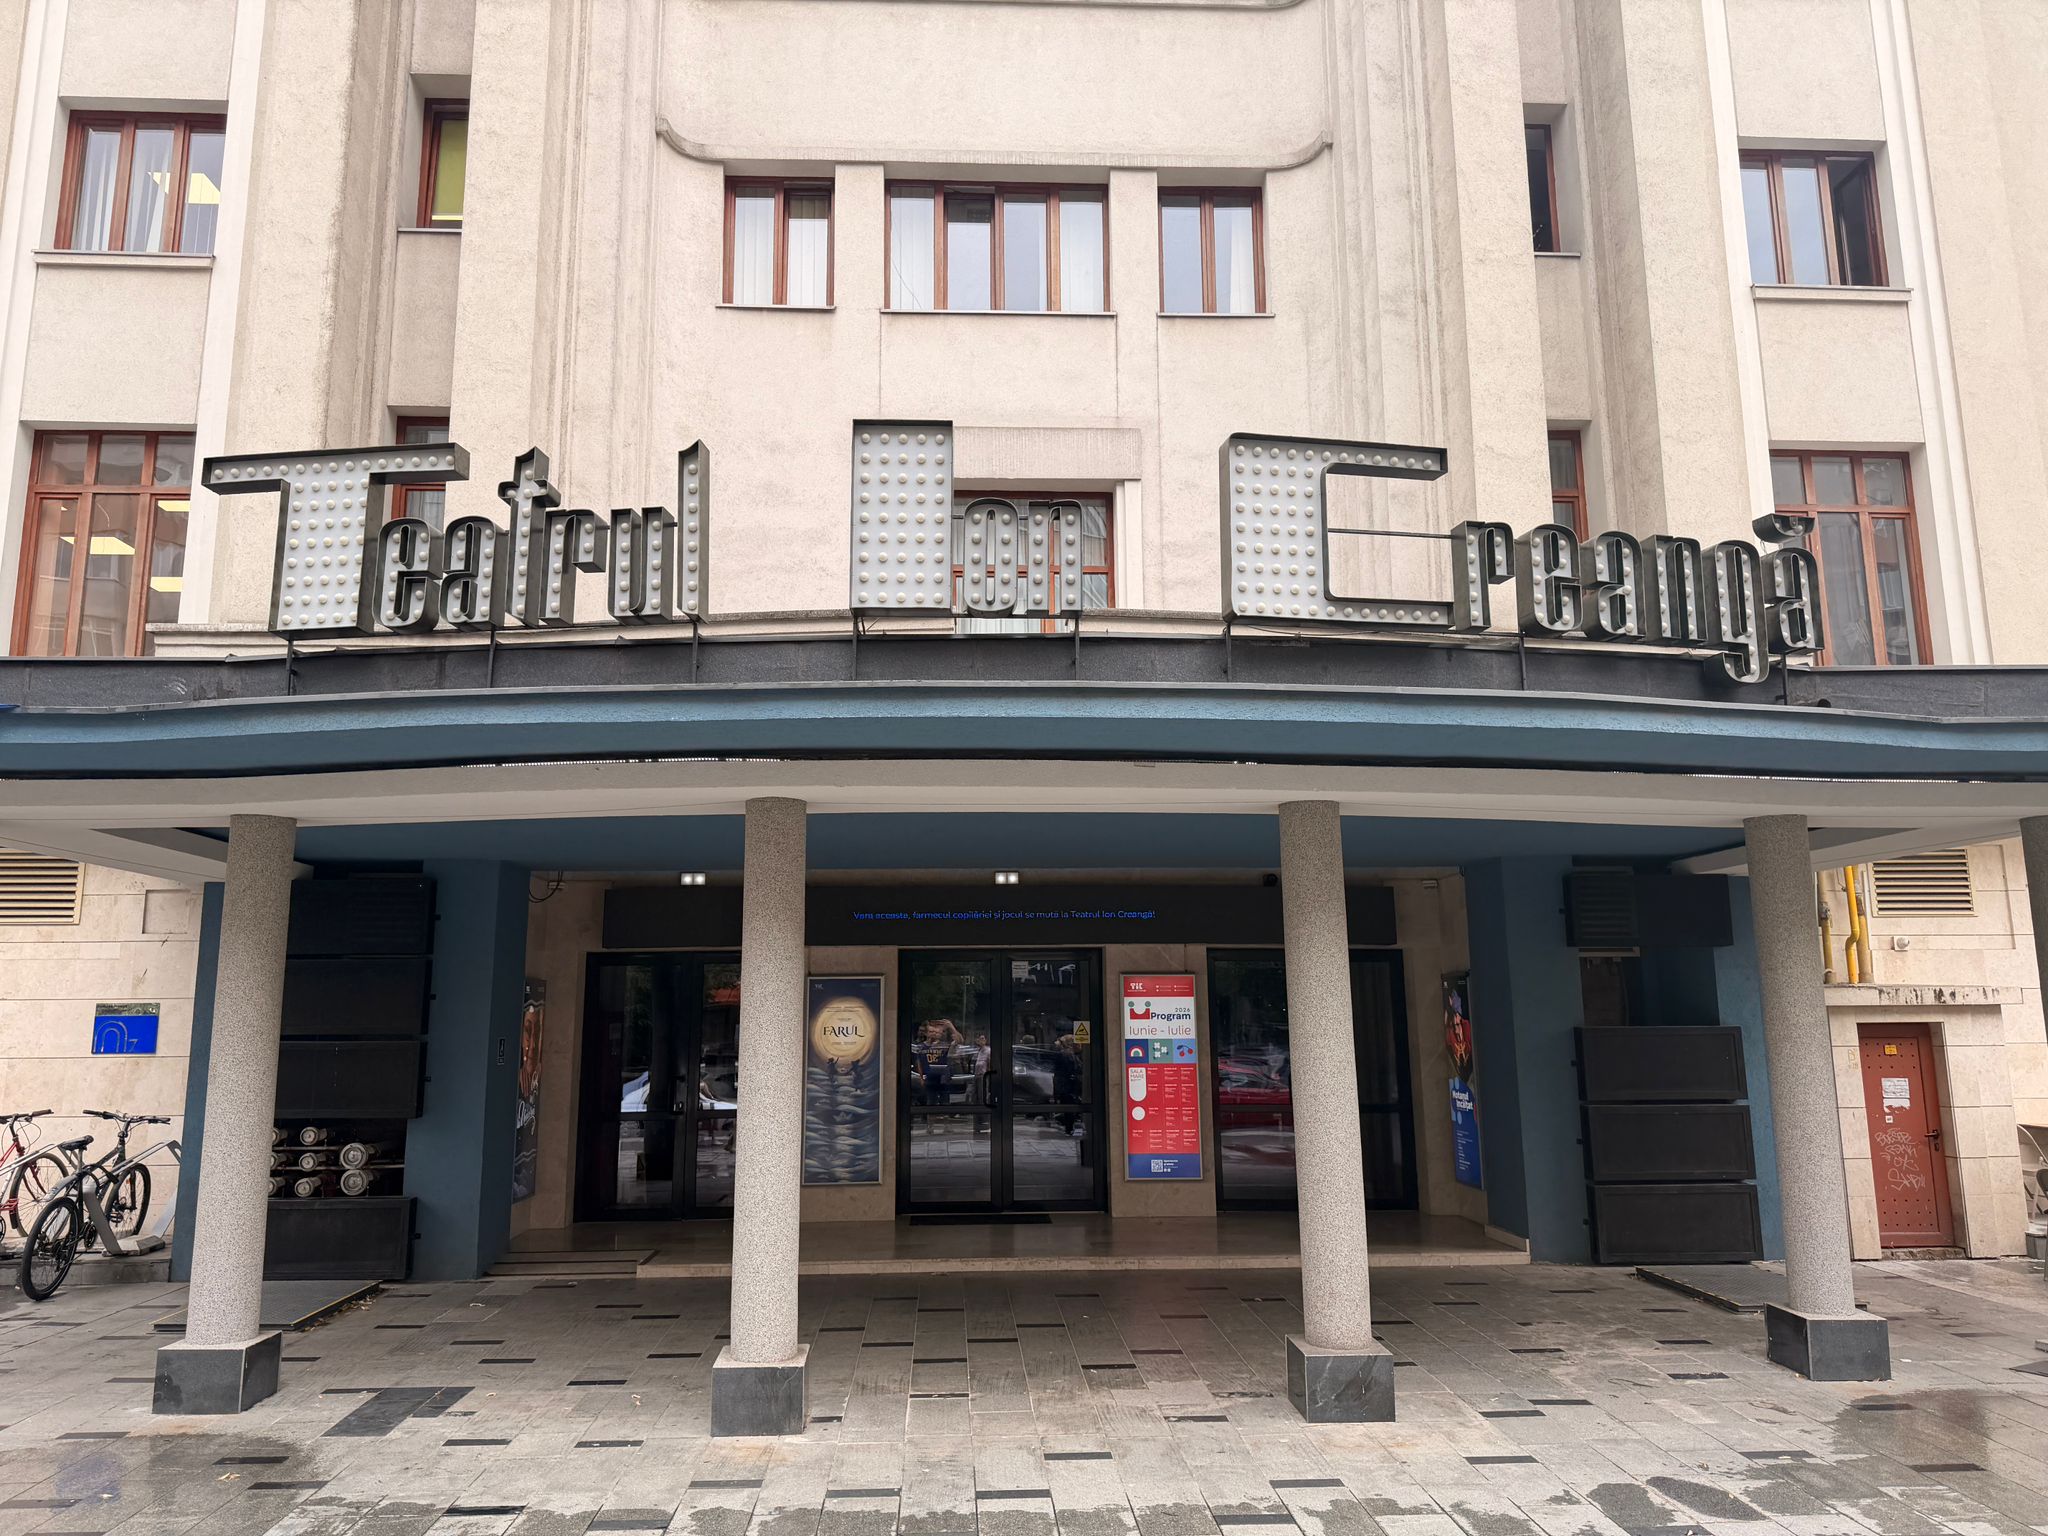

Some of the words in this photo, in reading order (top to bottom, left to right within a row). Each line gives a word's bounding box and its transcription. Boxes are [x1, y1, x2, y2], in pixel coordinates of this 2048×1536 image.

[204, 439, 709, 641] Teatrul
[851, 419, 1082, 618] Ion
[1220, 432, 1825, 684] Creangă
[912, 910, 951, 919] farmecul
[1002, 910, 1023, 920] jocul
[1070, 910, 1100, 919] Teatrul
[1102, 910, 1116, 919] Ion
[1151, 1012, 1191, 1021] Program
[823, 1024, 865, 1038] FARUL
